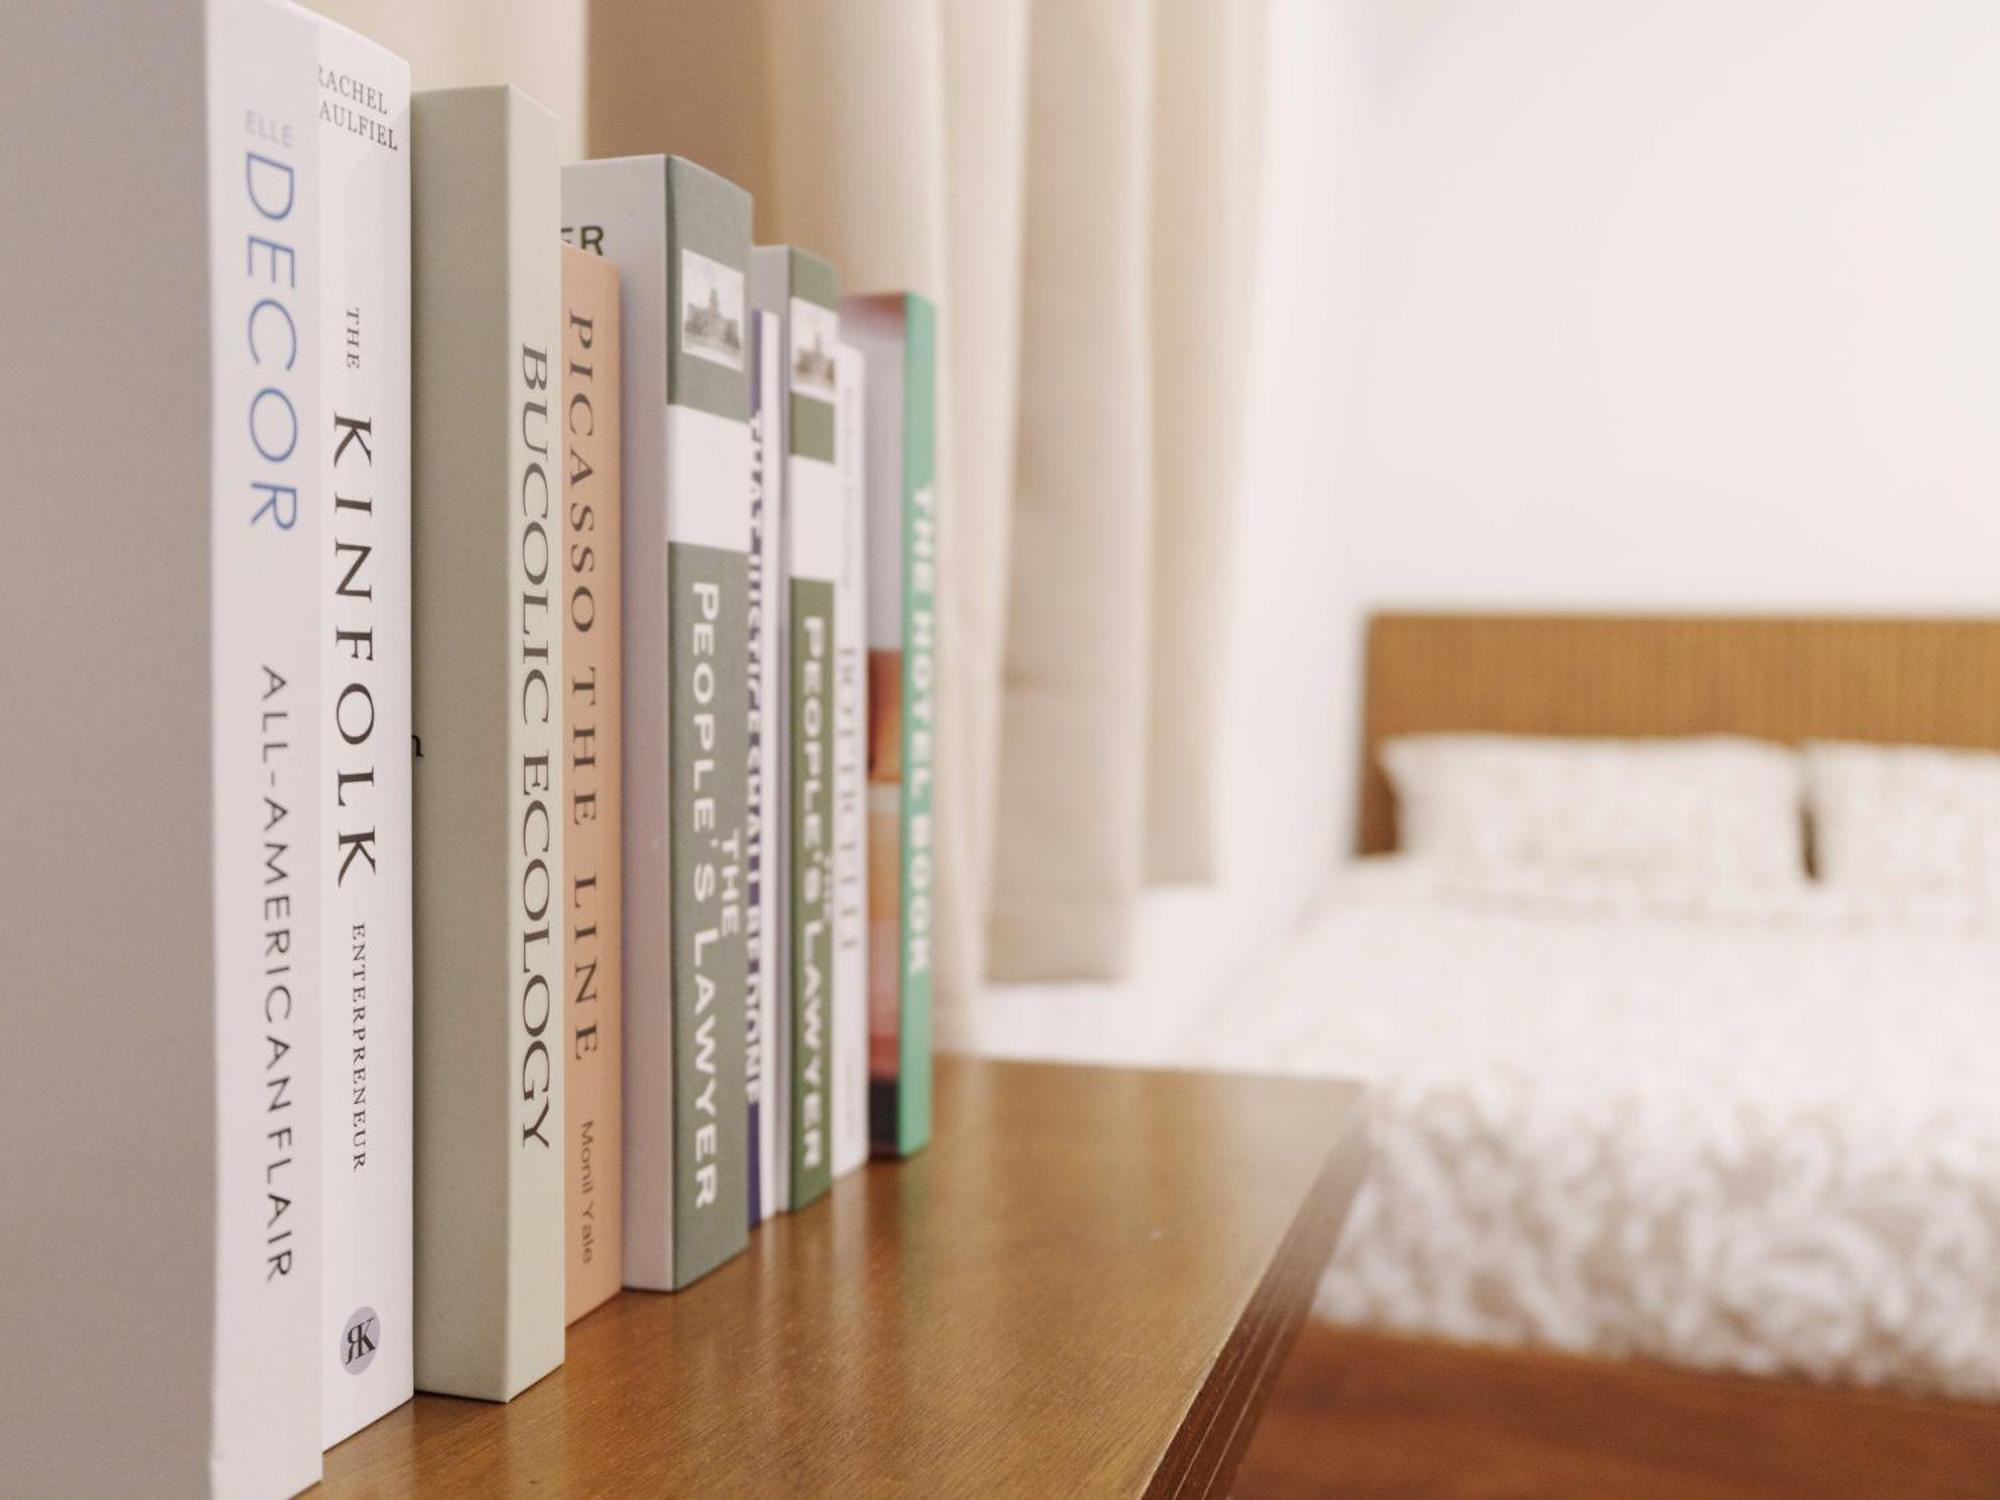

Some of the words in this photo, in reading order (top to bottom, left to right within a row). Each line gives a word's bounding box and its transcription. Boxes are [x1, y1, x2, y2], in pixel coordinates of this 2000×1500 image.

[245, 109, 294, 149] ELLE
[246, 151, 298, 531] DECOR
[346, 307, 361, 369] THE
[522, 343, 550, 726] BUCOLIC
[569, 311, 596, 634] PICASSO
[911, 484, 936, 592] THE
[333, 412, 376, 887] KINFOLK
[572, 666, 597, 827] THE
[693, 581, 720, 902] PEOPLE'S
[803, 616, 824, 904] PEOPLE'S
[911, 610, 935, 798] HOTEL
[523, 751, 551, 1150] ECOLOGY
[574, 874, 598, 1062] LINE
[721, 827, 741, 937] THE
[910, 814, 932, 976] BOOK
[352, 923, 367, 1171] ENTERPRENEUR
[694, 927, 721, 1209] LAWYER
[804, 919, 824, 1168] LAWYER
